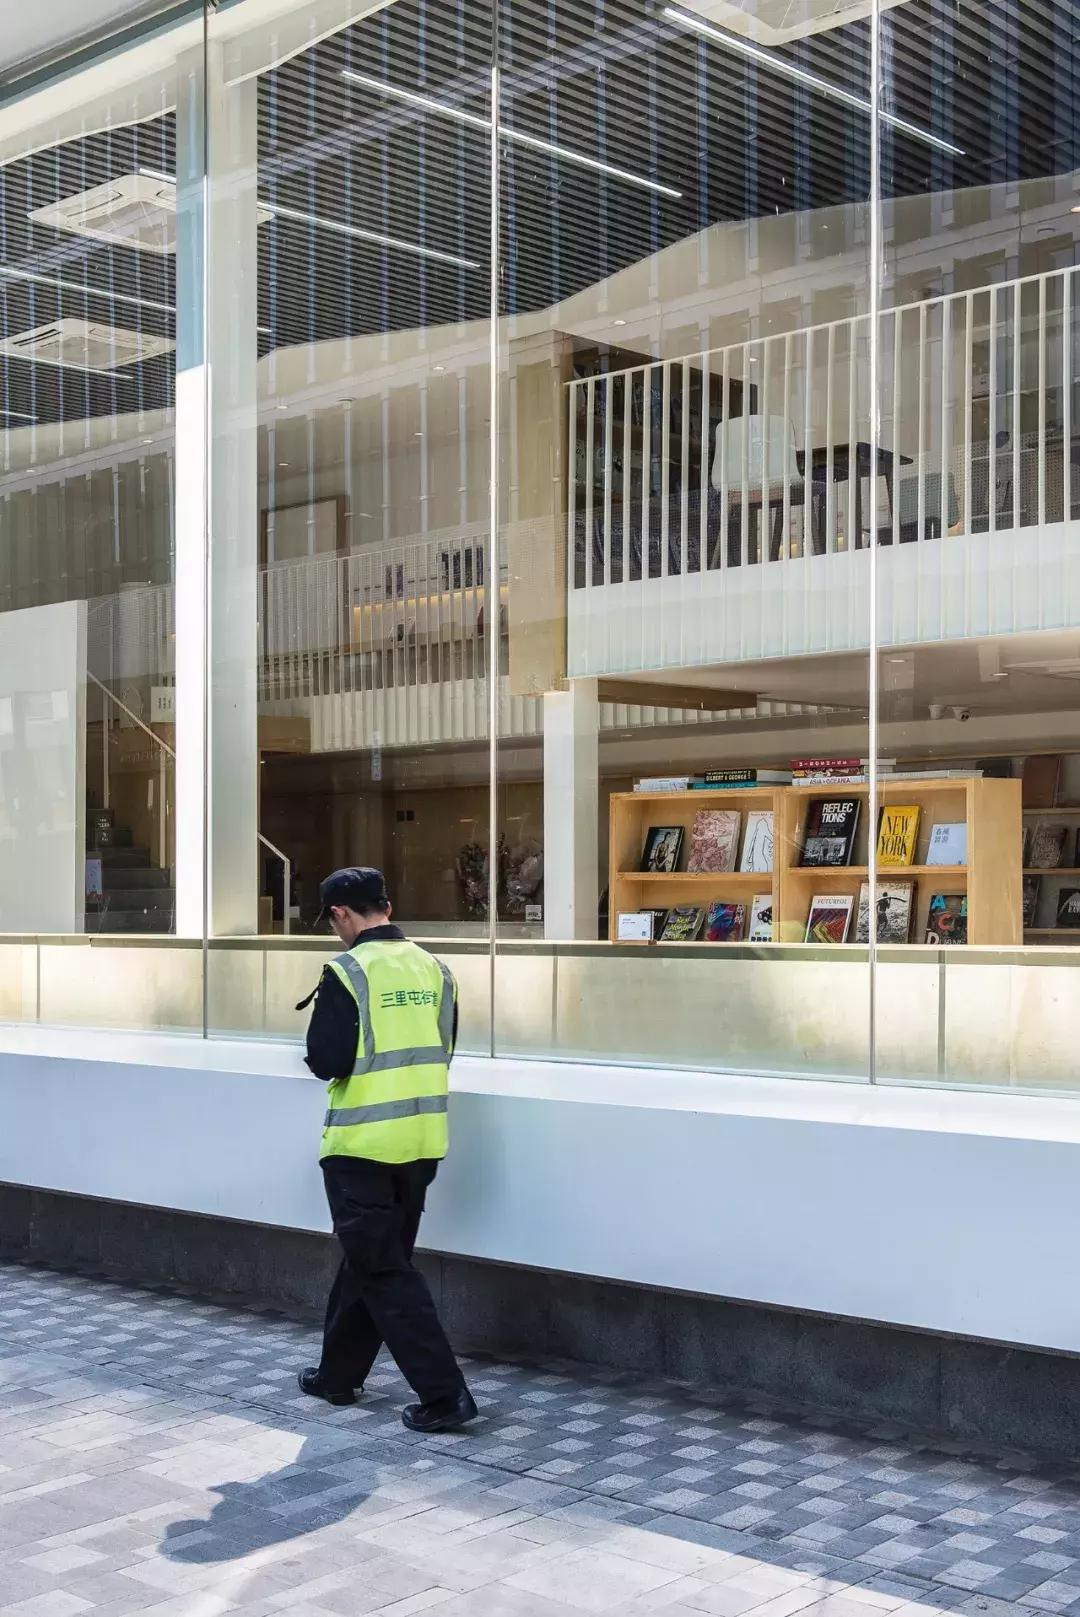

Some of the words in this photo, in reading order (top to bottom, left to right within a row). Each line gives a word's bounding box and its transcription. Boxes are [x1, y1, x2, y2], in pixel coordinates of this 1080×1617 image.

[822, 803, 853, 813] REFLEC
[821, 812, 846, 823] TIONS
[884, 815, 913, 836] NEW
[880, 835, 912, 857] YORK
